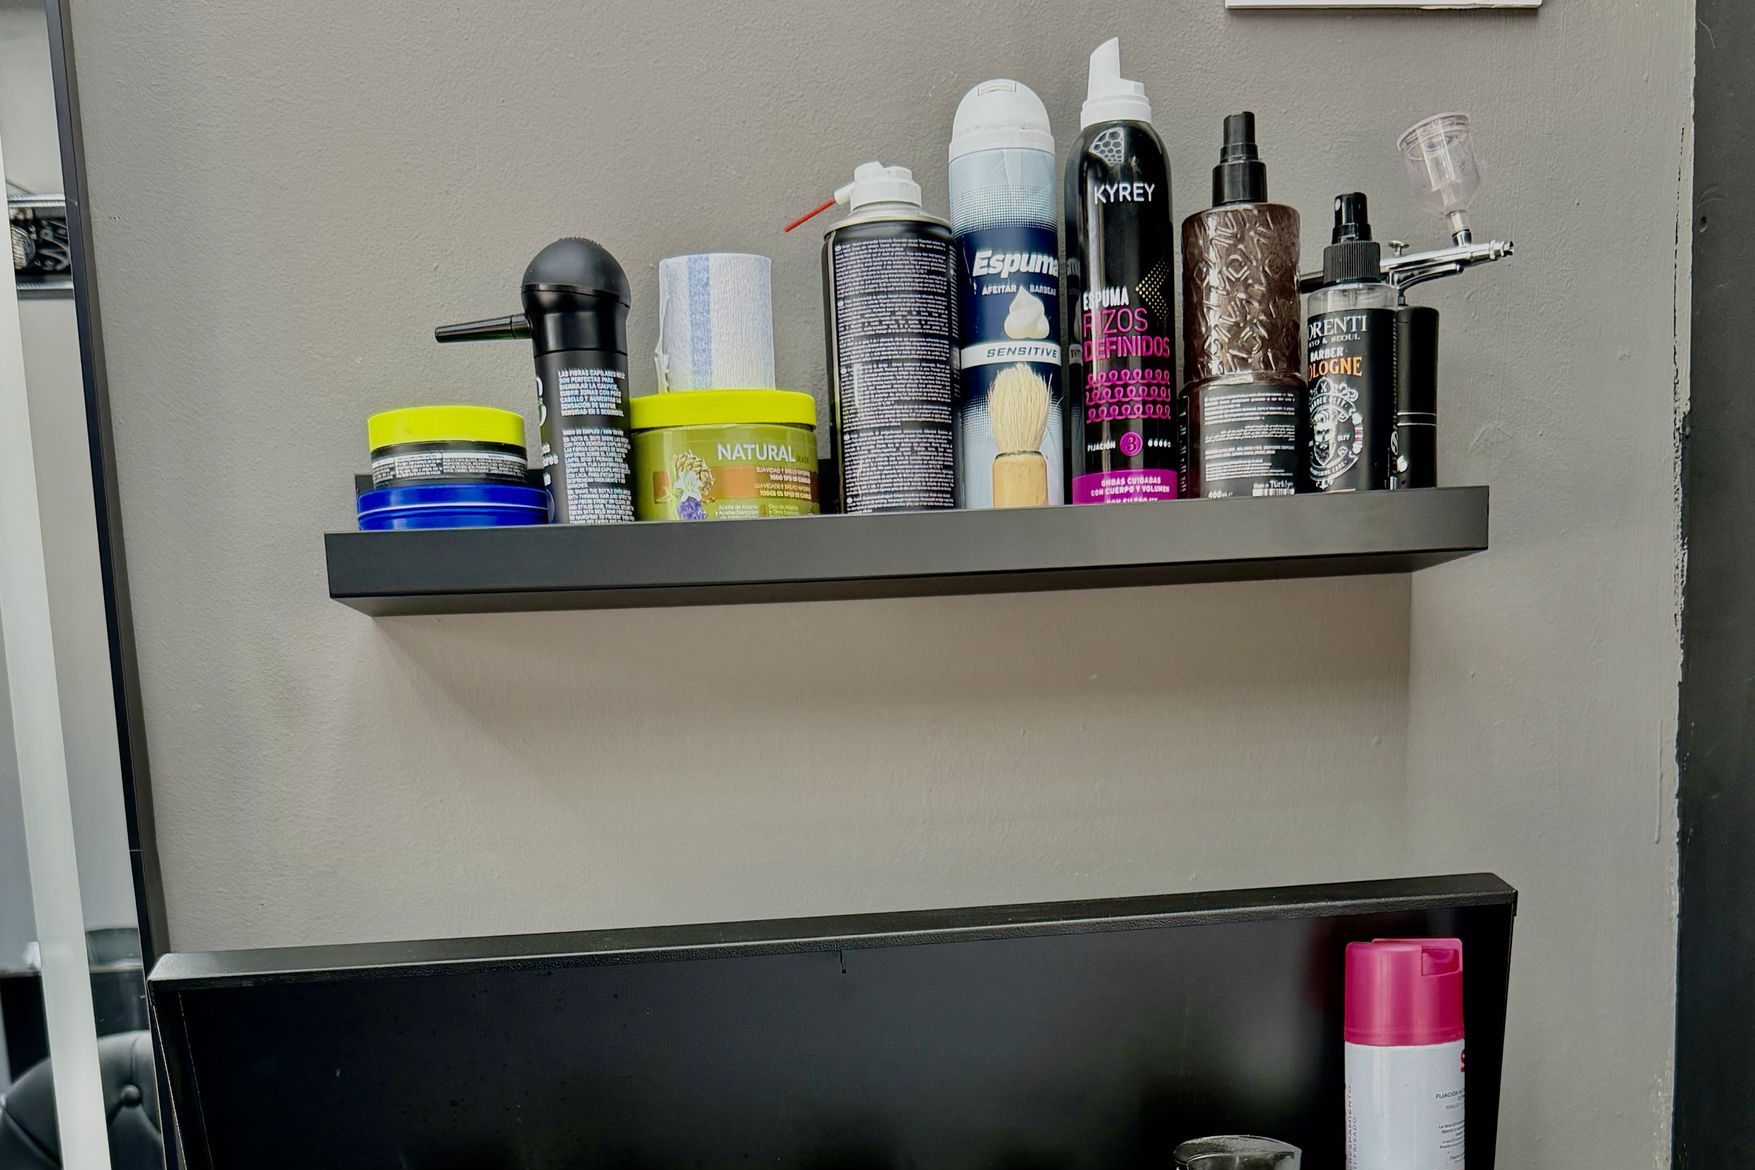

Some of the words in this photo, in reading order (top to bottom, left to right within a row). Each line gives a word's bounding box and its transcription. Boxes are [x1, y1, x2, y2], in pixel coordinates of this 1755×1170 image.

[1094, 182, 1155, 205] KYREY
[973, 250, 1059, 279] Espuma
[982, 284, 1017, 296] AFEITAR
[1083, 286, 1129, 311] ESPUMA
[1083, 308, 1148, 338] RIZOS
[987, 346, 1058, 358] SENSITIVE
[1083, 336, 1170, 362] DEFINIDOS
[717, 443, 796, 462] NATURAL
[1127, 475, 1162, 485] CUIDADAS
